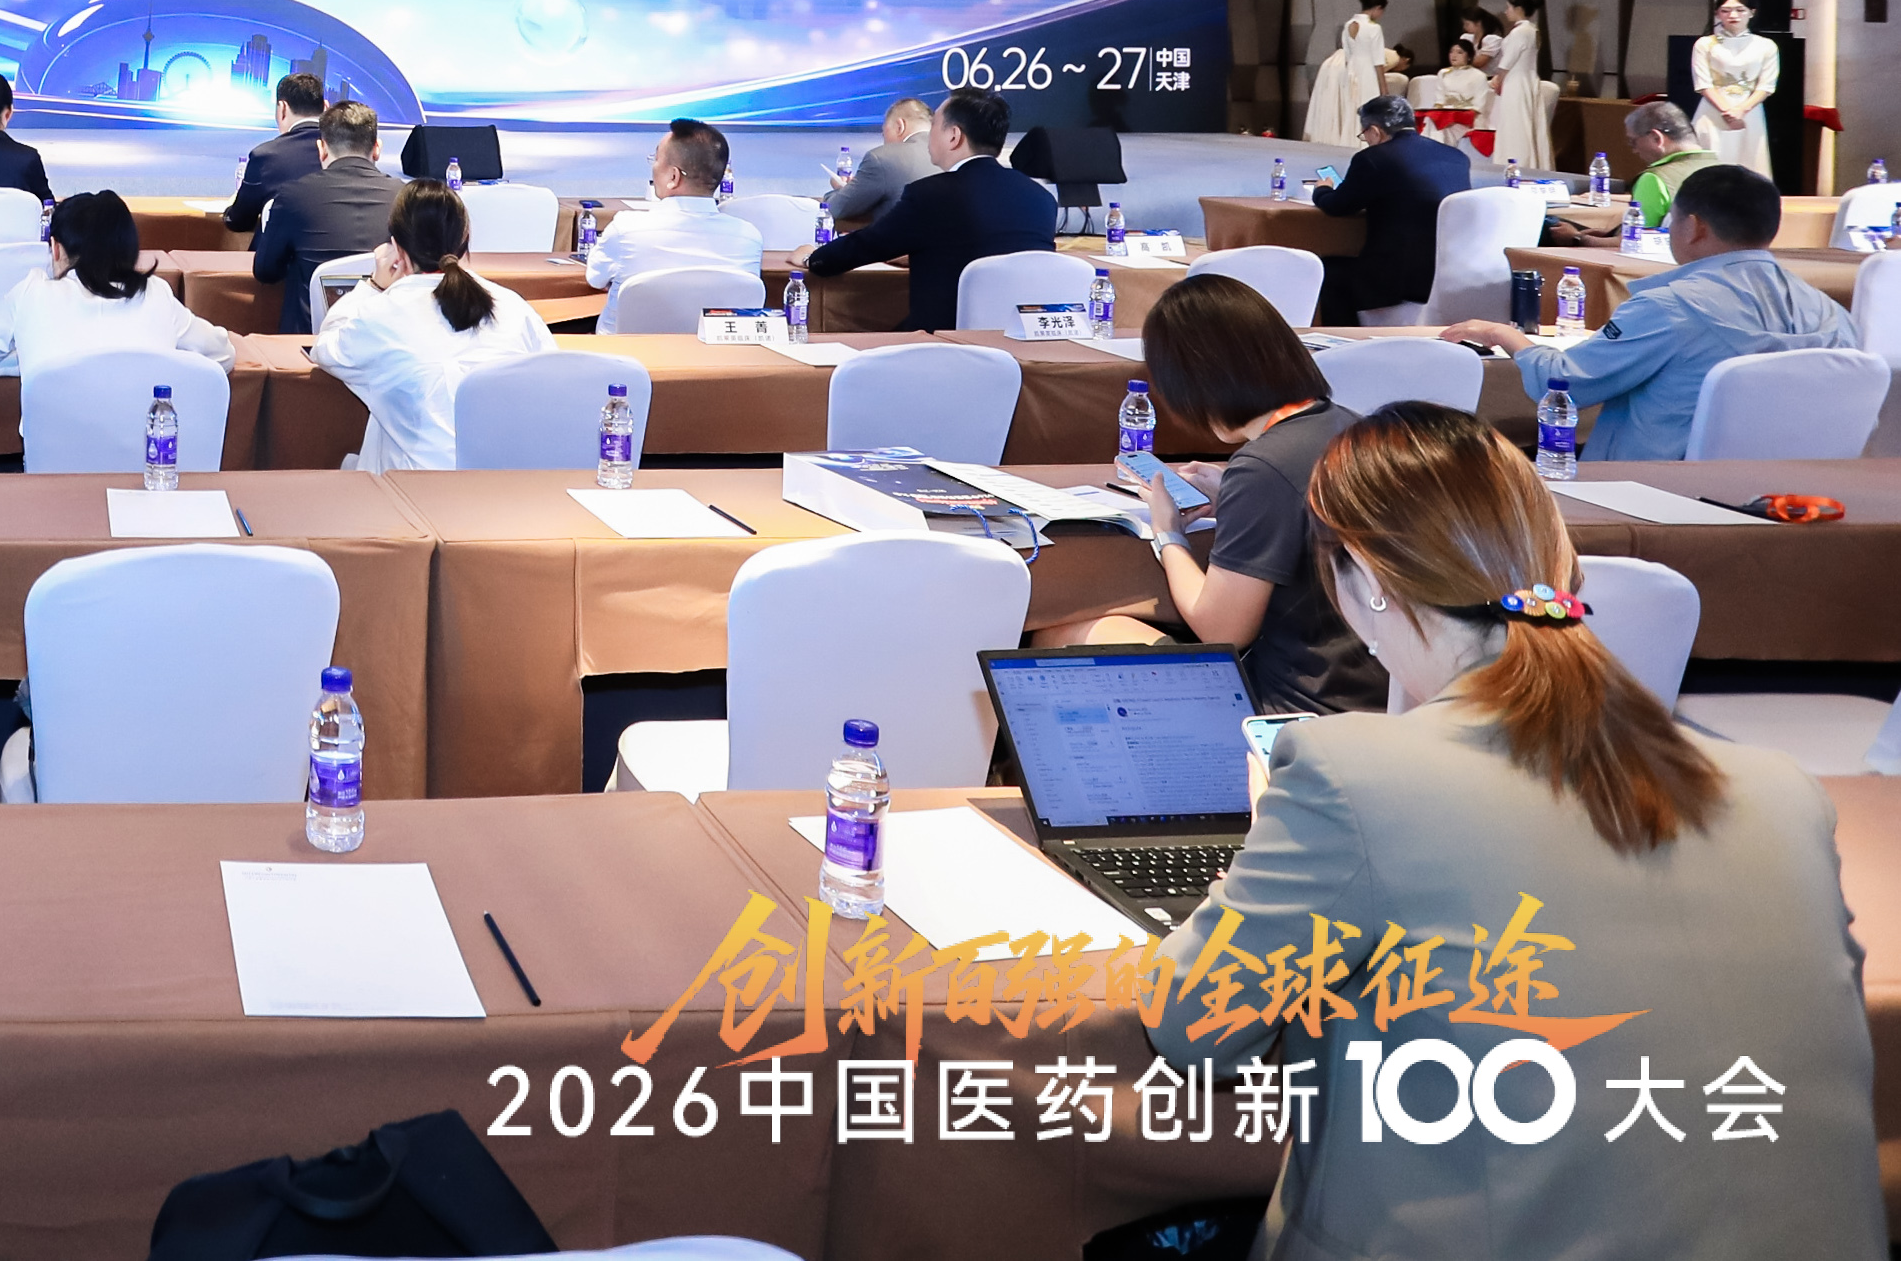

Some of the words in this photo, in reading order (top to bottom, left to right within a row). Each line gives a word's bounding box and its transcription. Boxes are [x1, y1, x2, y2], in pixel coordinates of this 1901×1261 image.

[1156, 48, 1191, 68] 中国
[1096, 47, 1146, 90] 27
[1155, 71, 1191, 91] 天津
[1038, 316, 1076, 329] 李光泽
